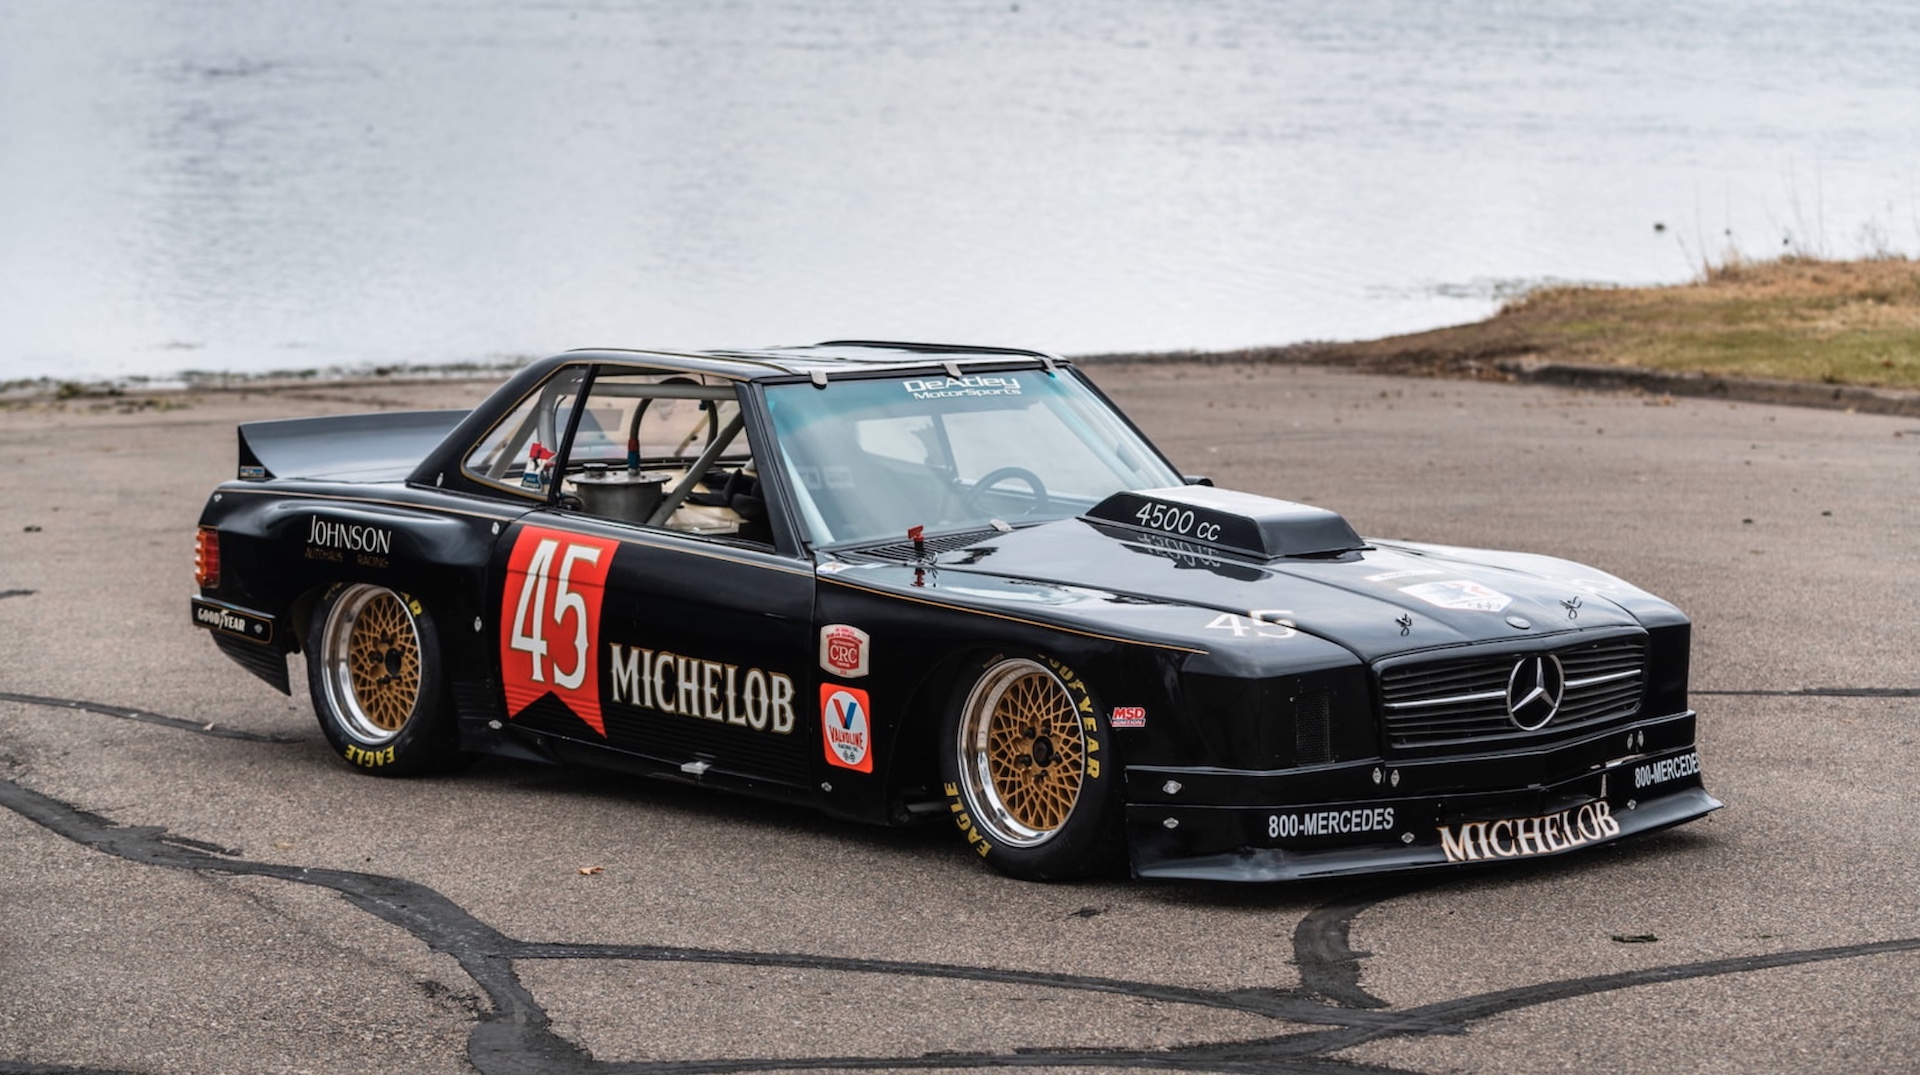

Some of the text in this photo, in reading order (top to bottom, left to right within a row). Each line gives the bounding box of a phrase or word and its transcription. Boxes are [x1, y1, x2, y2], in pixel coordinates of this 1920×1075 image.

[903, 375, 1021, 393] DeAtley
[913, 387, 1022, 400] MotorSports
[307, 515, 391, 553] JOHNSON
[1135, 502, 1221, 541] 4500 cc
[197, 607, 246, 632] GOODYEAR
[510, 538, 603, 690] 45
[1203, 608, 1297, 639] 45
[830, 644, 858, 664] CRC
[608, 641, 797, 735] MICHELOB
[1113, 708, 1145, 720] MSD
[828, 724, 864, 750] VALVOLINE
[344, 744, 396, 768] EAGLE
[943, 781, 993, 858] EAGLE
[1268, 807, 1395, 838] 800-MERCEDES
[1437, 800, 1620, 862] MICHELOB
